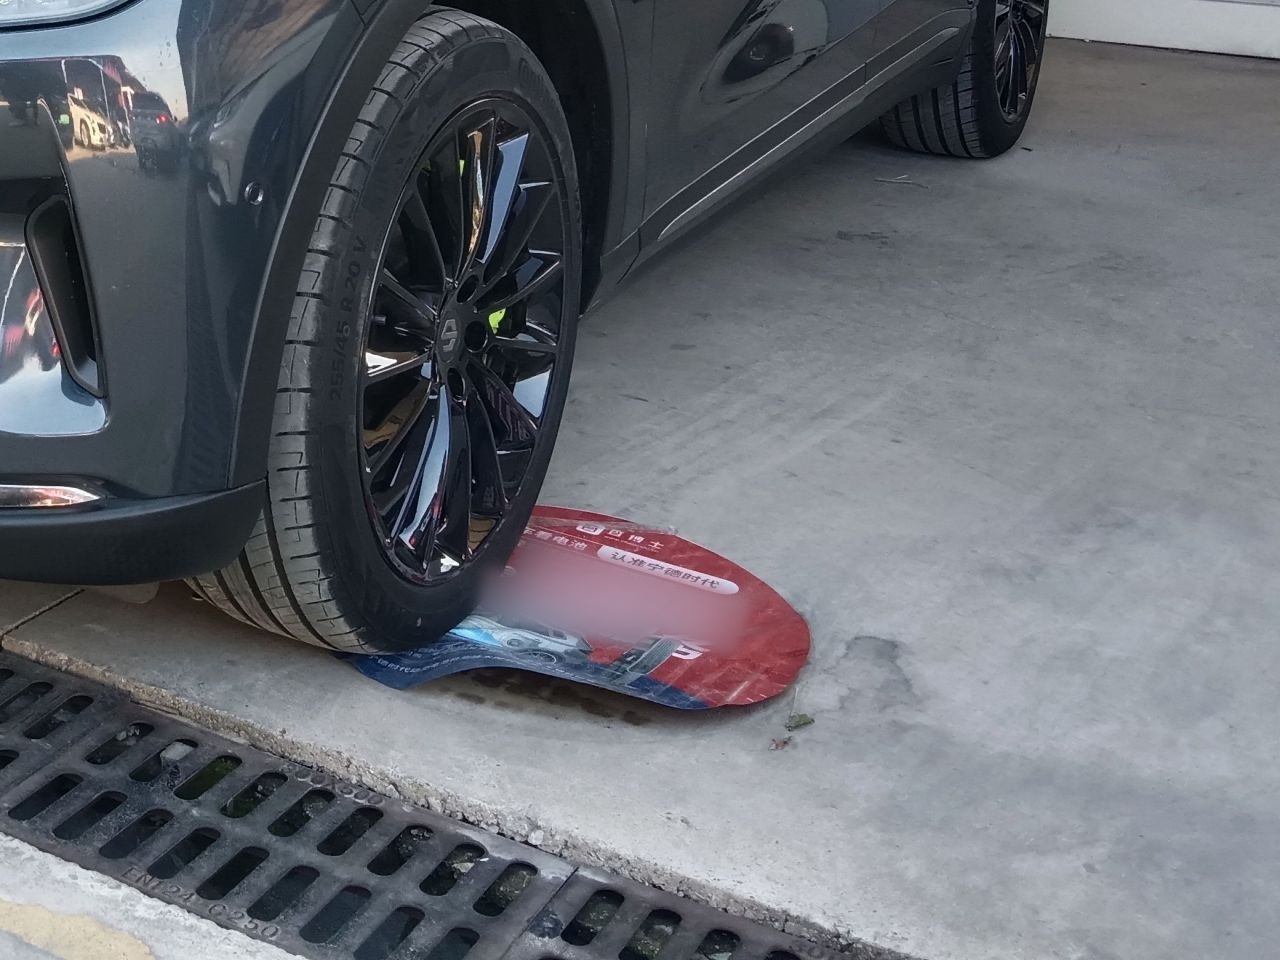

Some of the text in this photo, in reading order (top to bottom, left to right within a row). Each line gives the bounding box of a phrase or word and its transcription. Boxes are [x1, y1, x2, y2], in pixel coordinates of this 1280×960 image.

[610, 551, 720, 590] 认准宁德时代
[207, 902, 282, 940] C250
